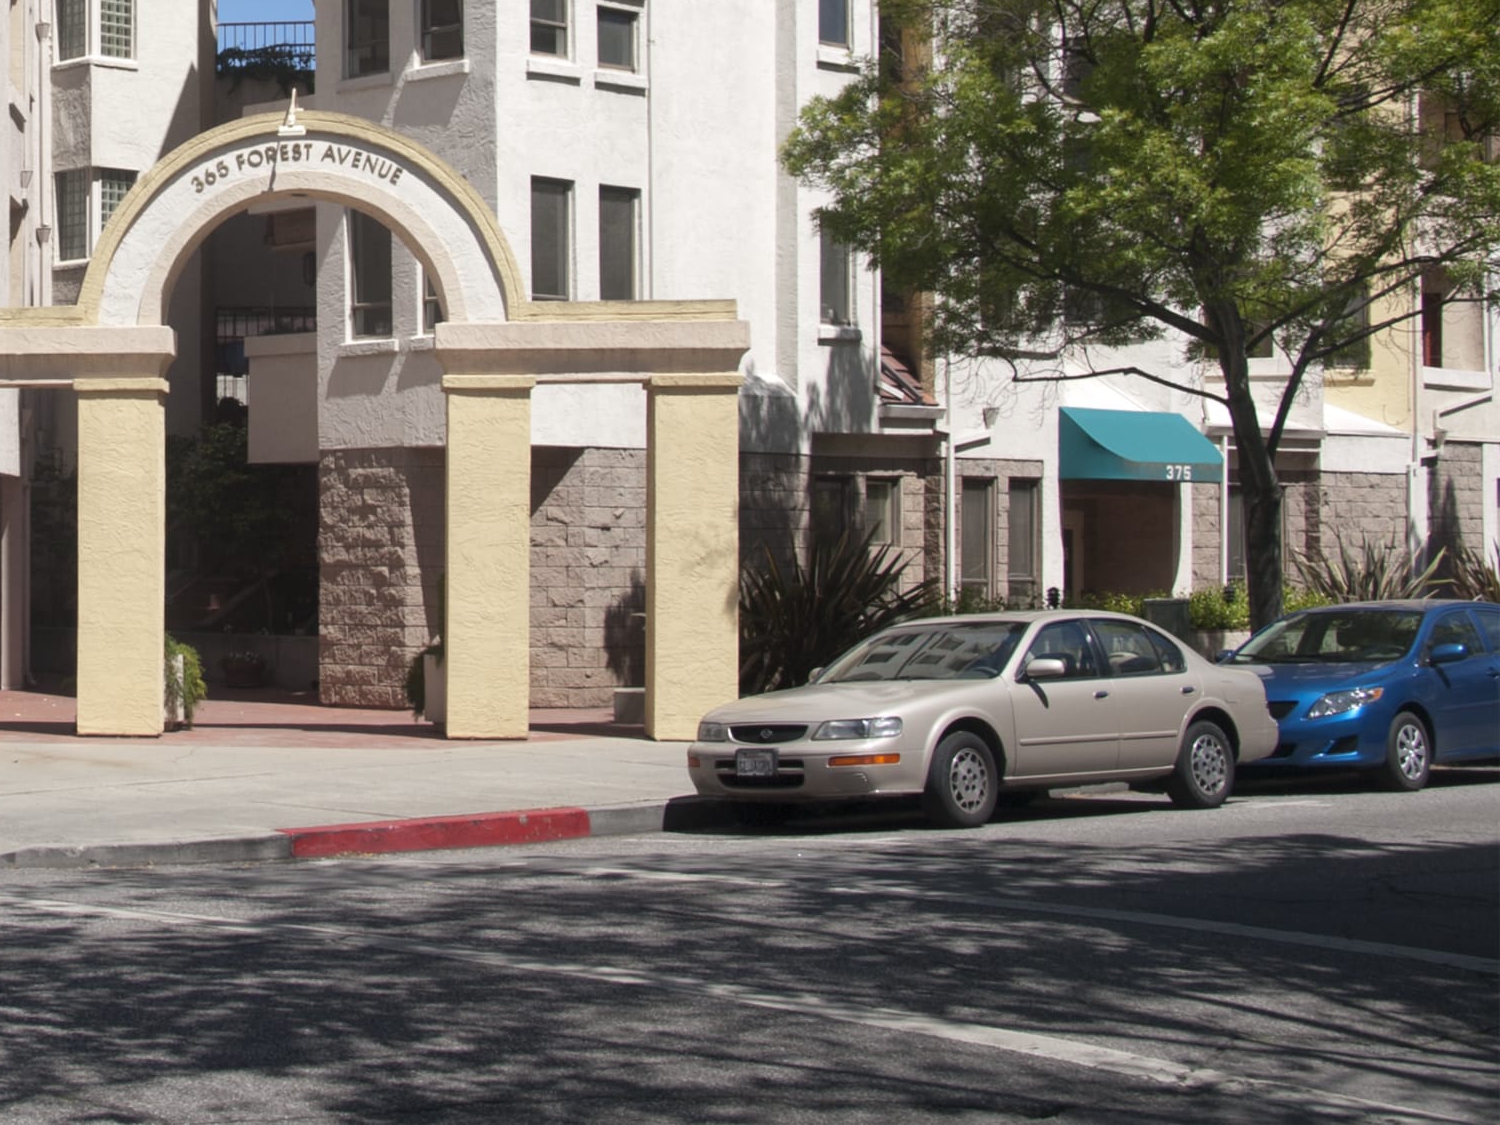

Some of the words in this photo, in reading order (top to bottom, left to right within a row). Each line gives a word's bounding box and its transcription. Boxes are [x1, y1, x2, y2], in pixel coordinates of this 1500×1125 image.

[191, 161, 230, 194] 365
[236, 143, 313, 172] FOREST
[321, 144, 404, 187] AVENUE
[1165, 464, 1192, 481] 375
